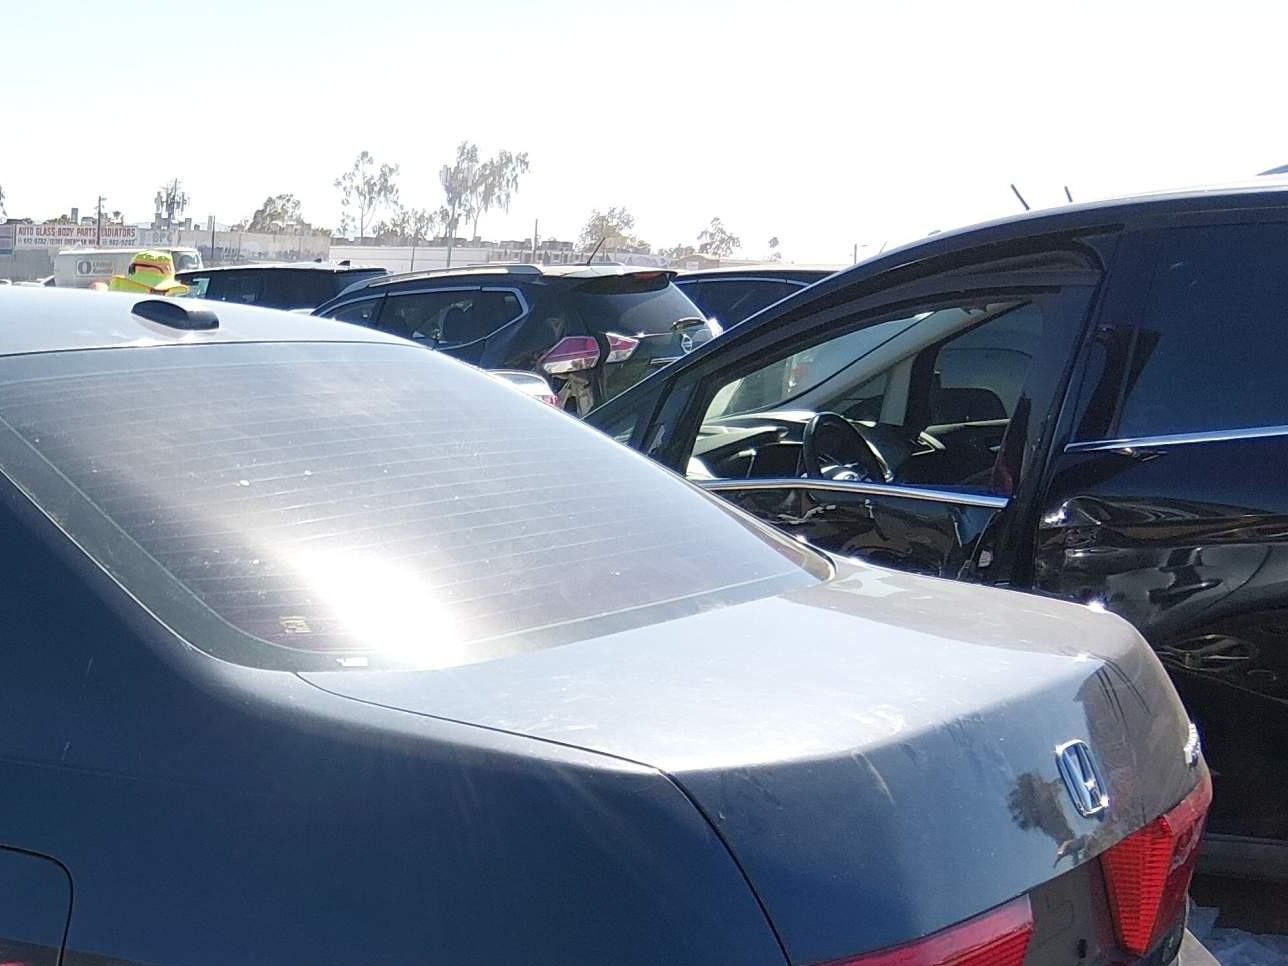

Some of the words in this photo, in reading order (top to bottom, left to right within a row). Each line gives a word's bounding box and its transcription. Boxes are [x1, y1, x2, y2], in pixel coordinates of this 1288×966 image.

[18, 226, 33, 236] AUTO
[36, 227, 55, 236] GLASS
[77, 227, 97, 237] PARTS
